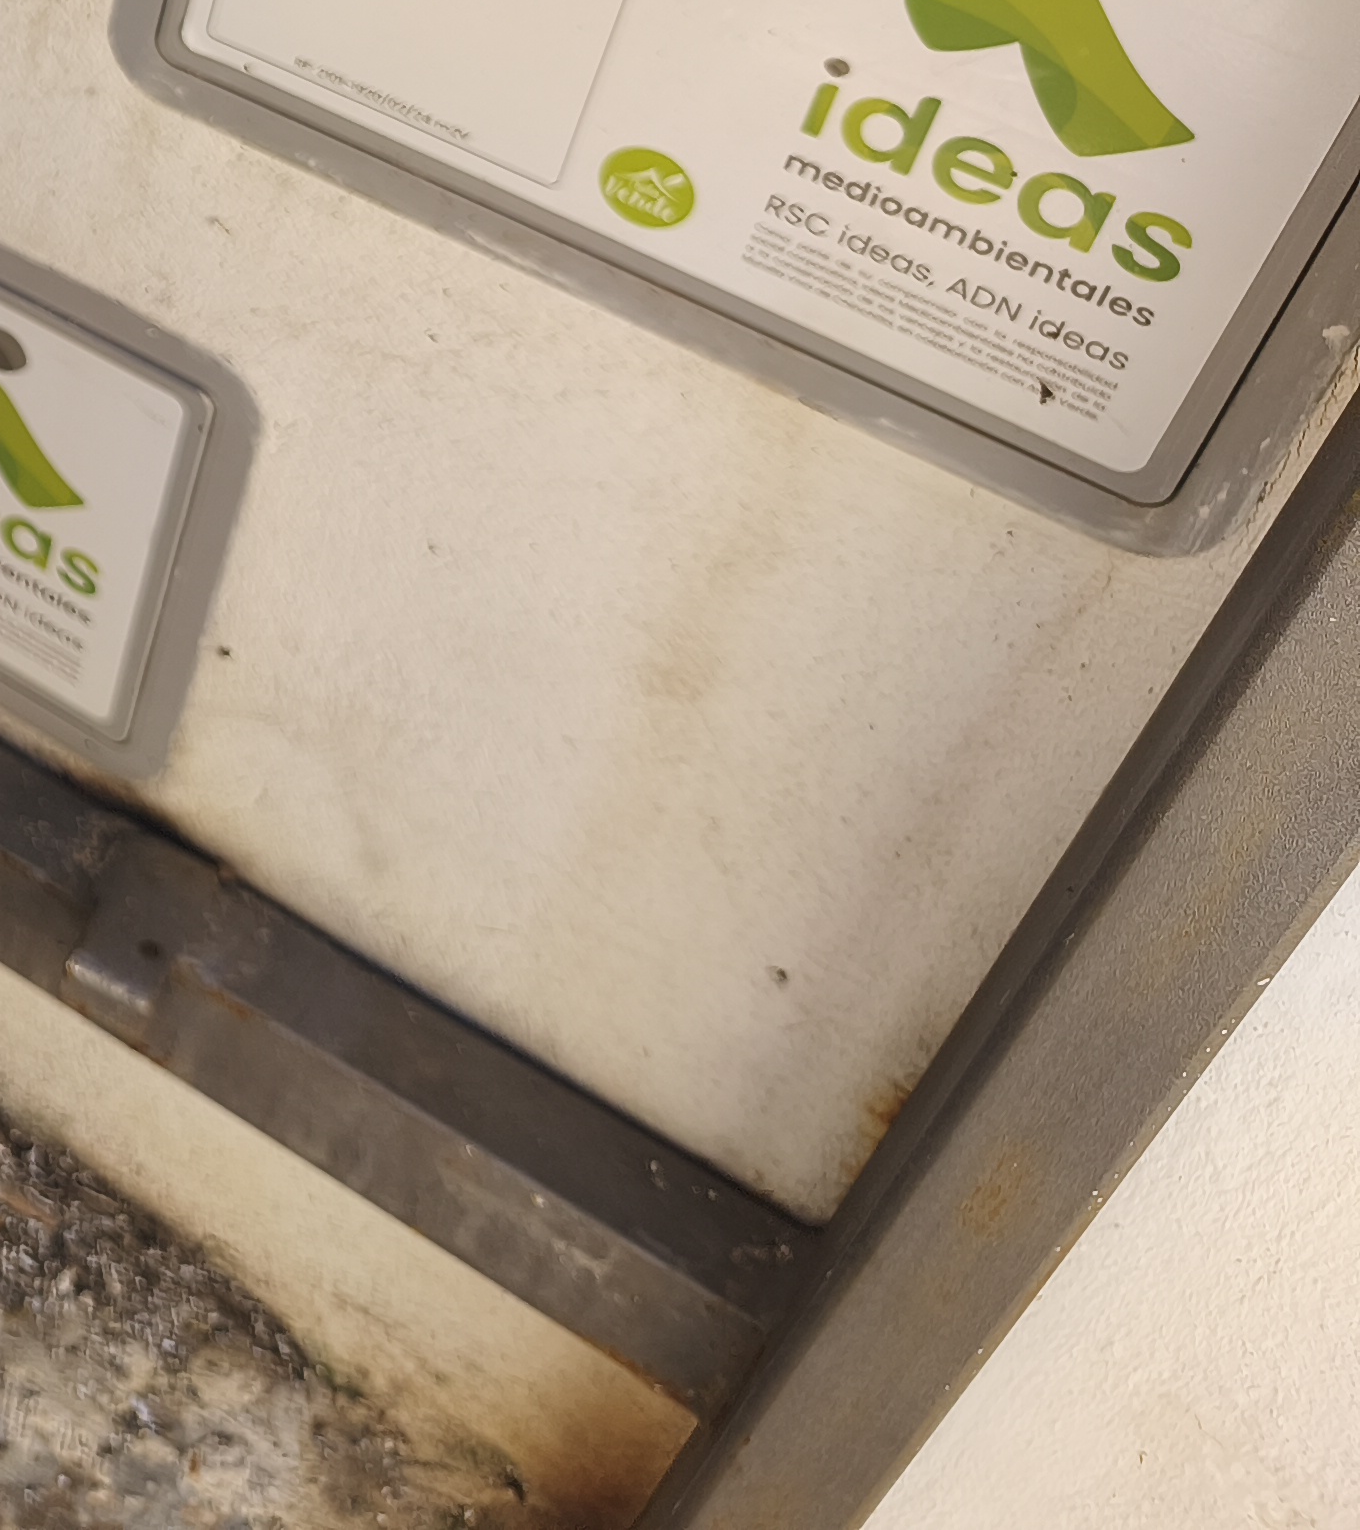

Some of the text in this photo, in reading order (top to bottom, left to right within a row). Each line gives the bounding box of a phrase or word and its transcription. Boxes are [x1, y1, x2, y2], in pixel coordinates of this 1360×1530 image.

[782, 153, 1156, 328] medioambientales
[800, 56, 1194, 283] ideas
[764, 193, 1130, 371] RSC ideas, ADN ideas
